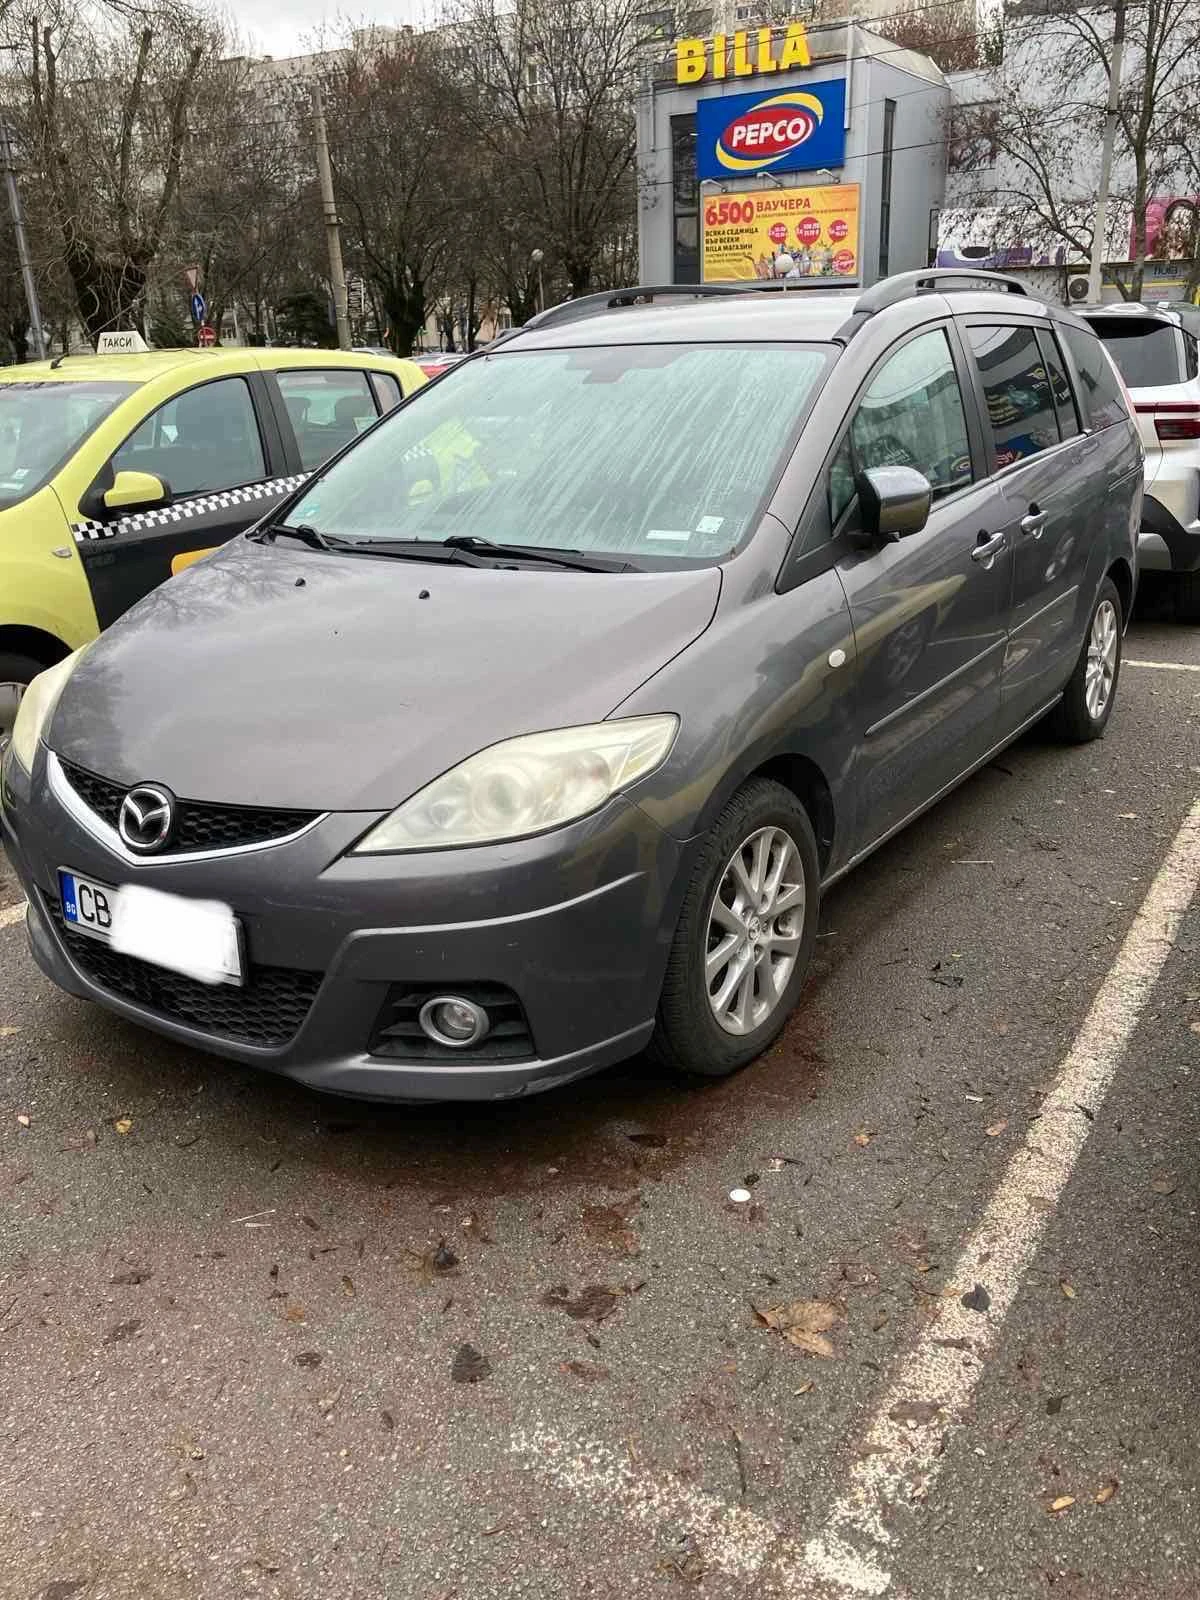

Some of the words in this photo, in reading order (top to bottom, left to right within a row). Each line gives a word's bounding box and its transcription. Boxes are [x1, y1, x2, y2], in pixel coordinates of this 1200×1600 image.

[676, 21, 812, 84] BILLA
[732, 117, 807, 147] PEPCO
[705, 201, 754, 226] 6500
[756, 198, 811, 212] ВАУЧЕРА
[705, 229, 726, 237] ВСЯКА
[726, 227, 759, 236] СЕДМИЦА
[103, 337, 132, 348] ТАКСИ
[65, 901, 76, 915] BG
